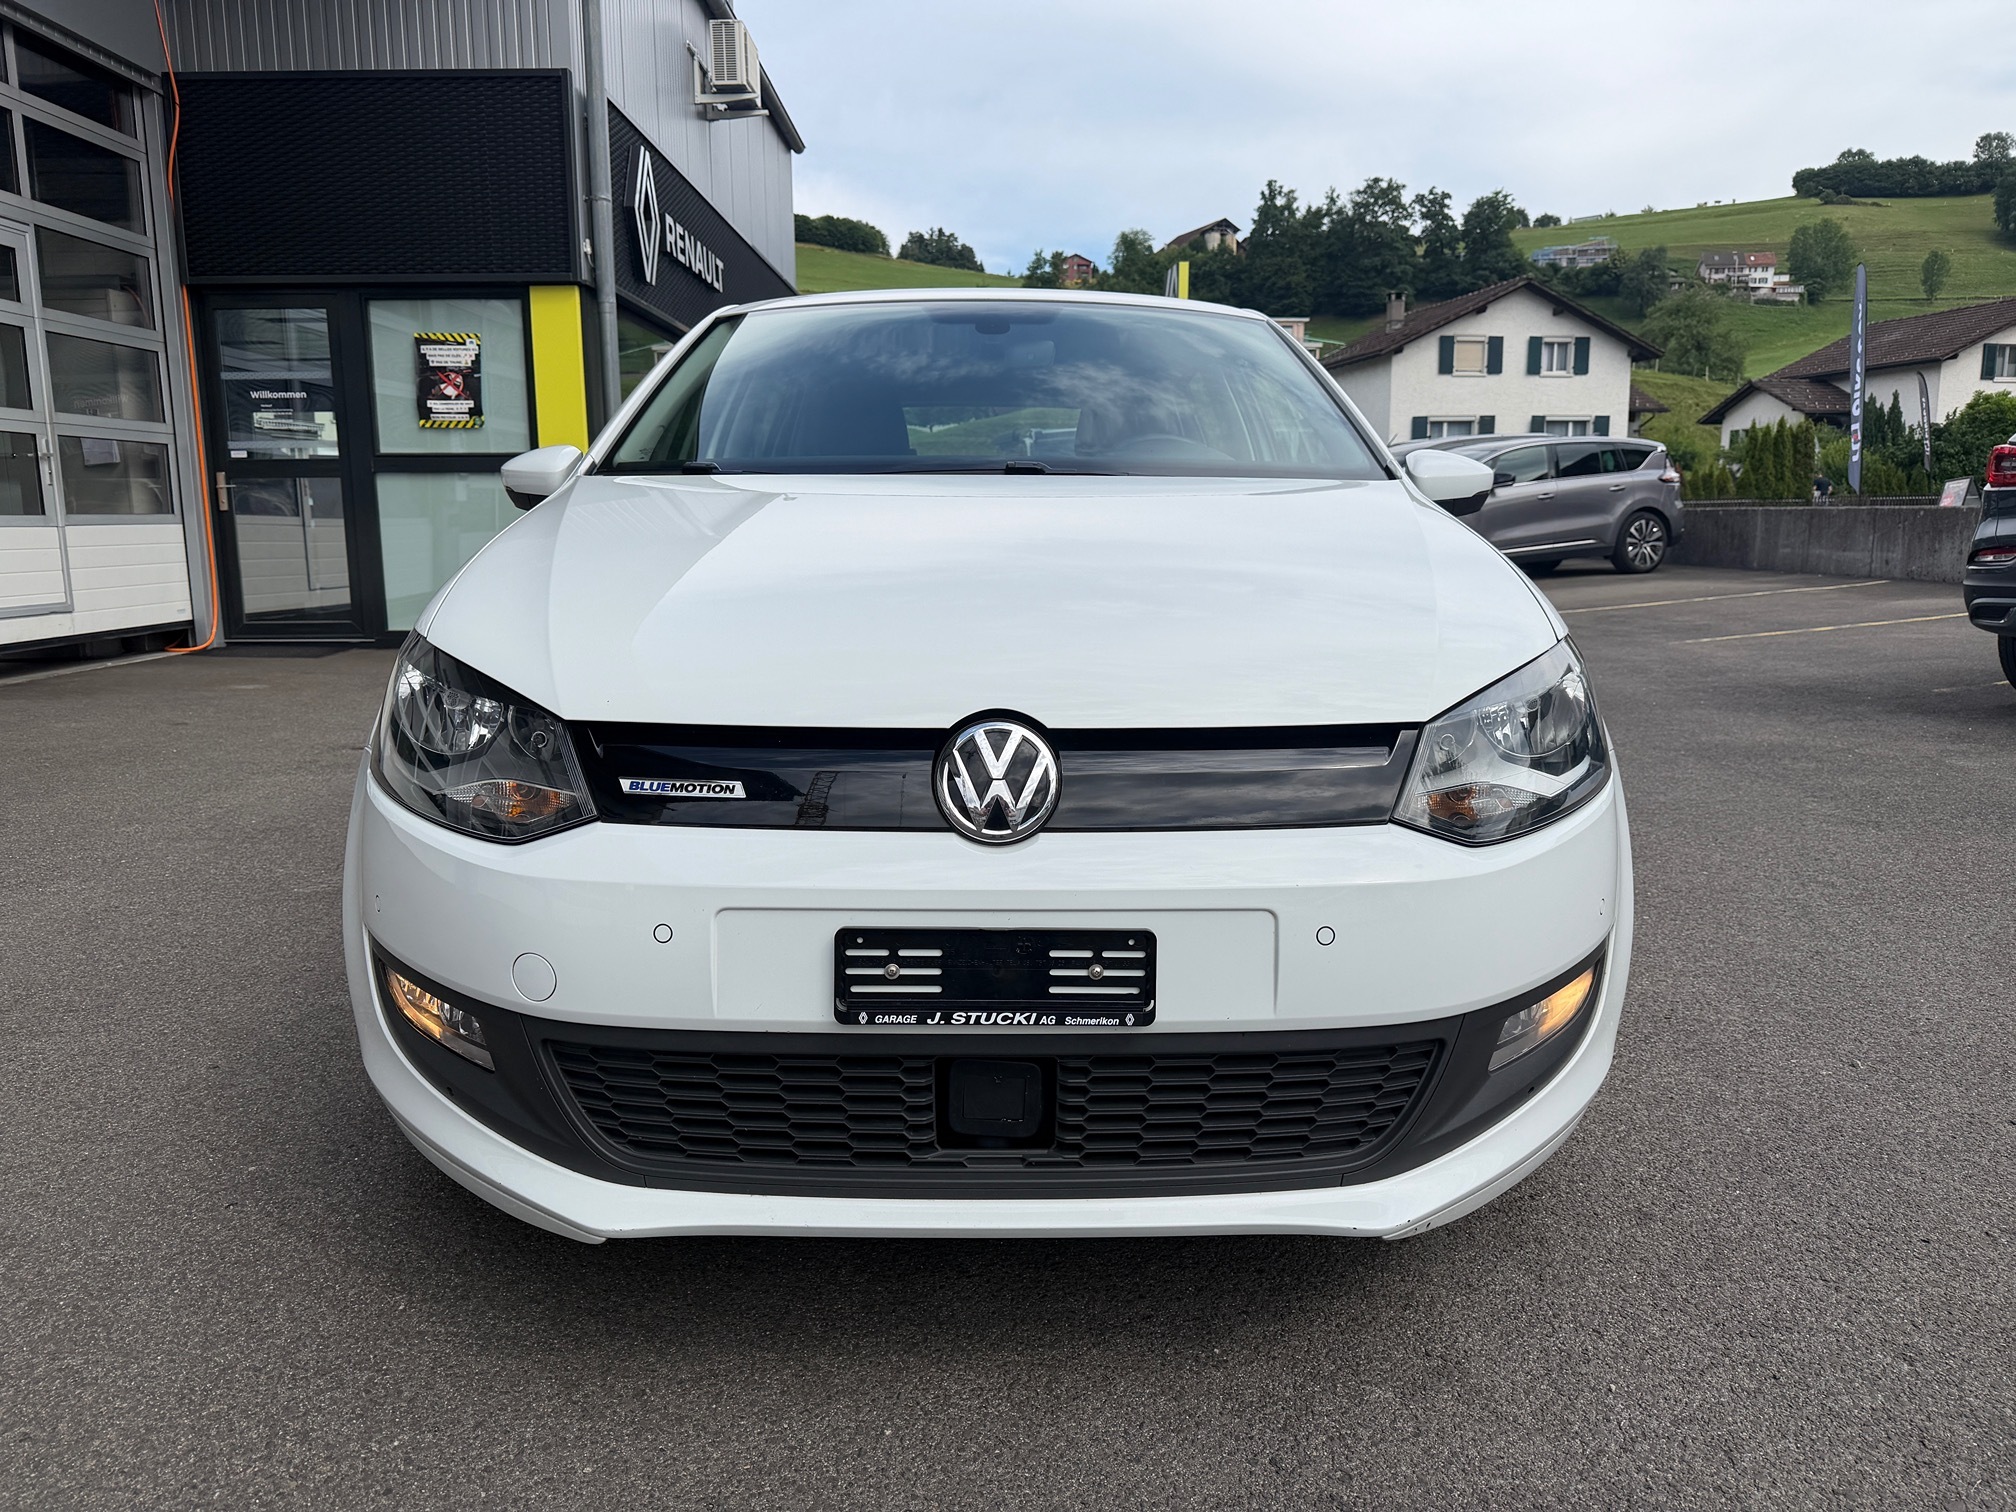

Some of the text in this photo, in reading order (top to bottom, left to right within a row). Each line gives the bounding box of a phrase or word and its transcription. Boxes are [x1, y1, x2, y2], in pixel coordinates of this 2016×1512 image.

[665, 212, 725, 293] RENAULT
[249, 390, 307, 399] Willkommen
[628, 781, 736, 795] BLUEMOTION
[941, 723, 1054, 841] VW
[874, 1012, 1120, 1026] GARAGE J. STUCKI AG Schmerikon
